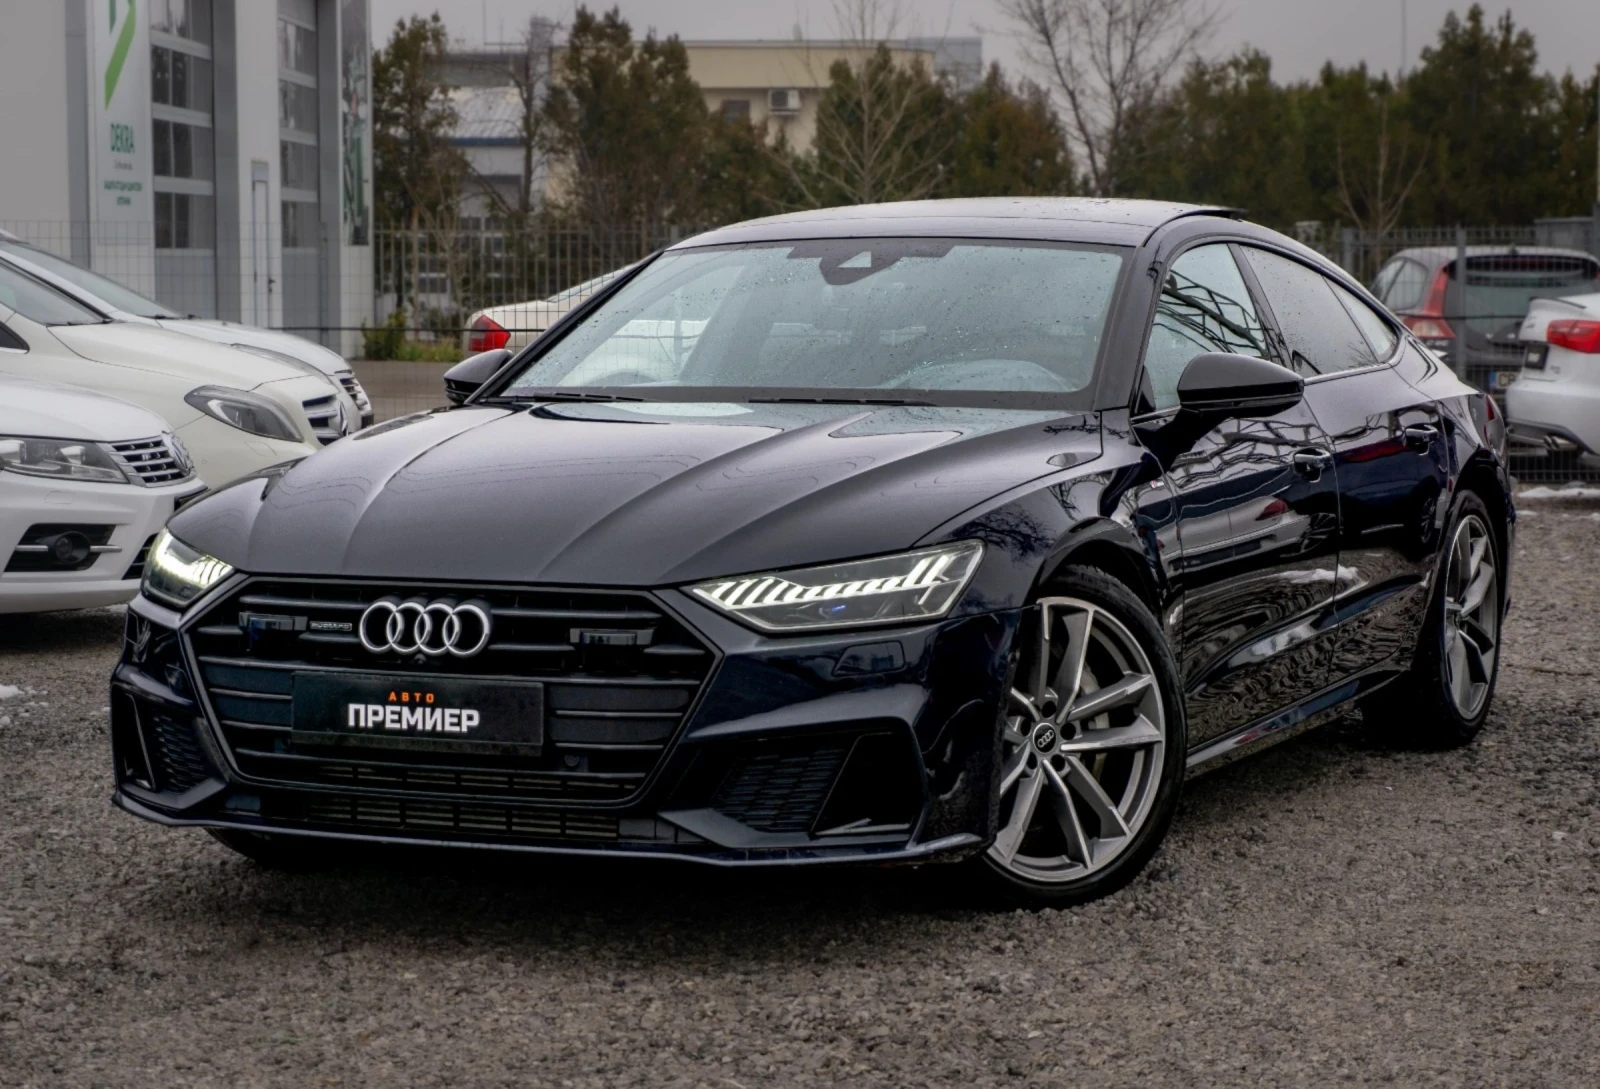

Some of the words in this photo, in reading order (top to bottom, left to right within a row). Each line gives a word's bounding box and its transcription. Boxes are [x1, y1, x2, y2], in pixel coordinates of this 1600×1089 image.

[110, 123, 135, 153] DEKRA
[388, 692, 435, 703] АВТО
[348, 703, 480, 732] ПРЕМИЕР
